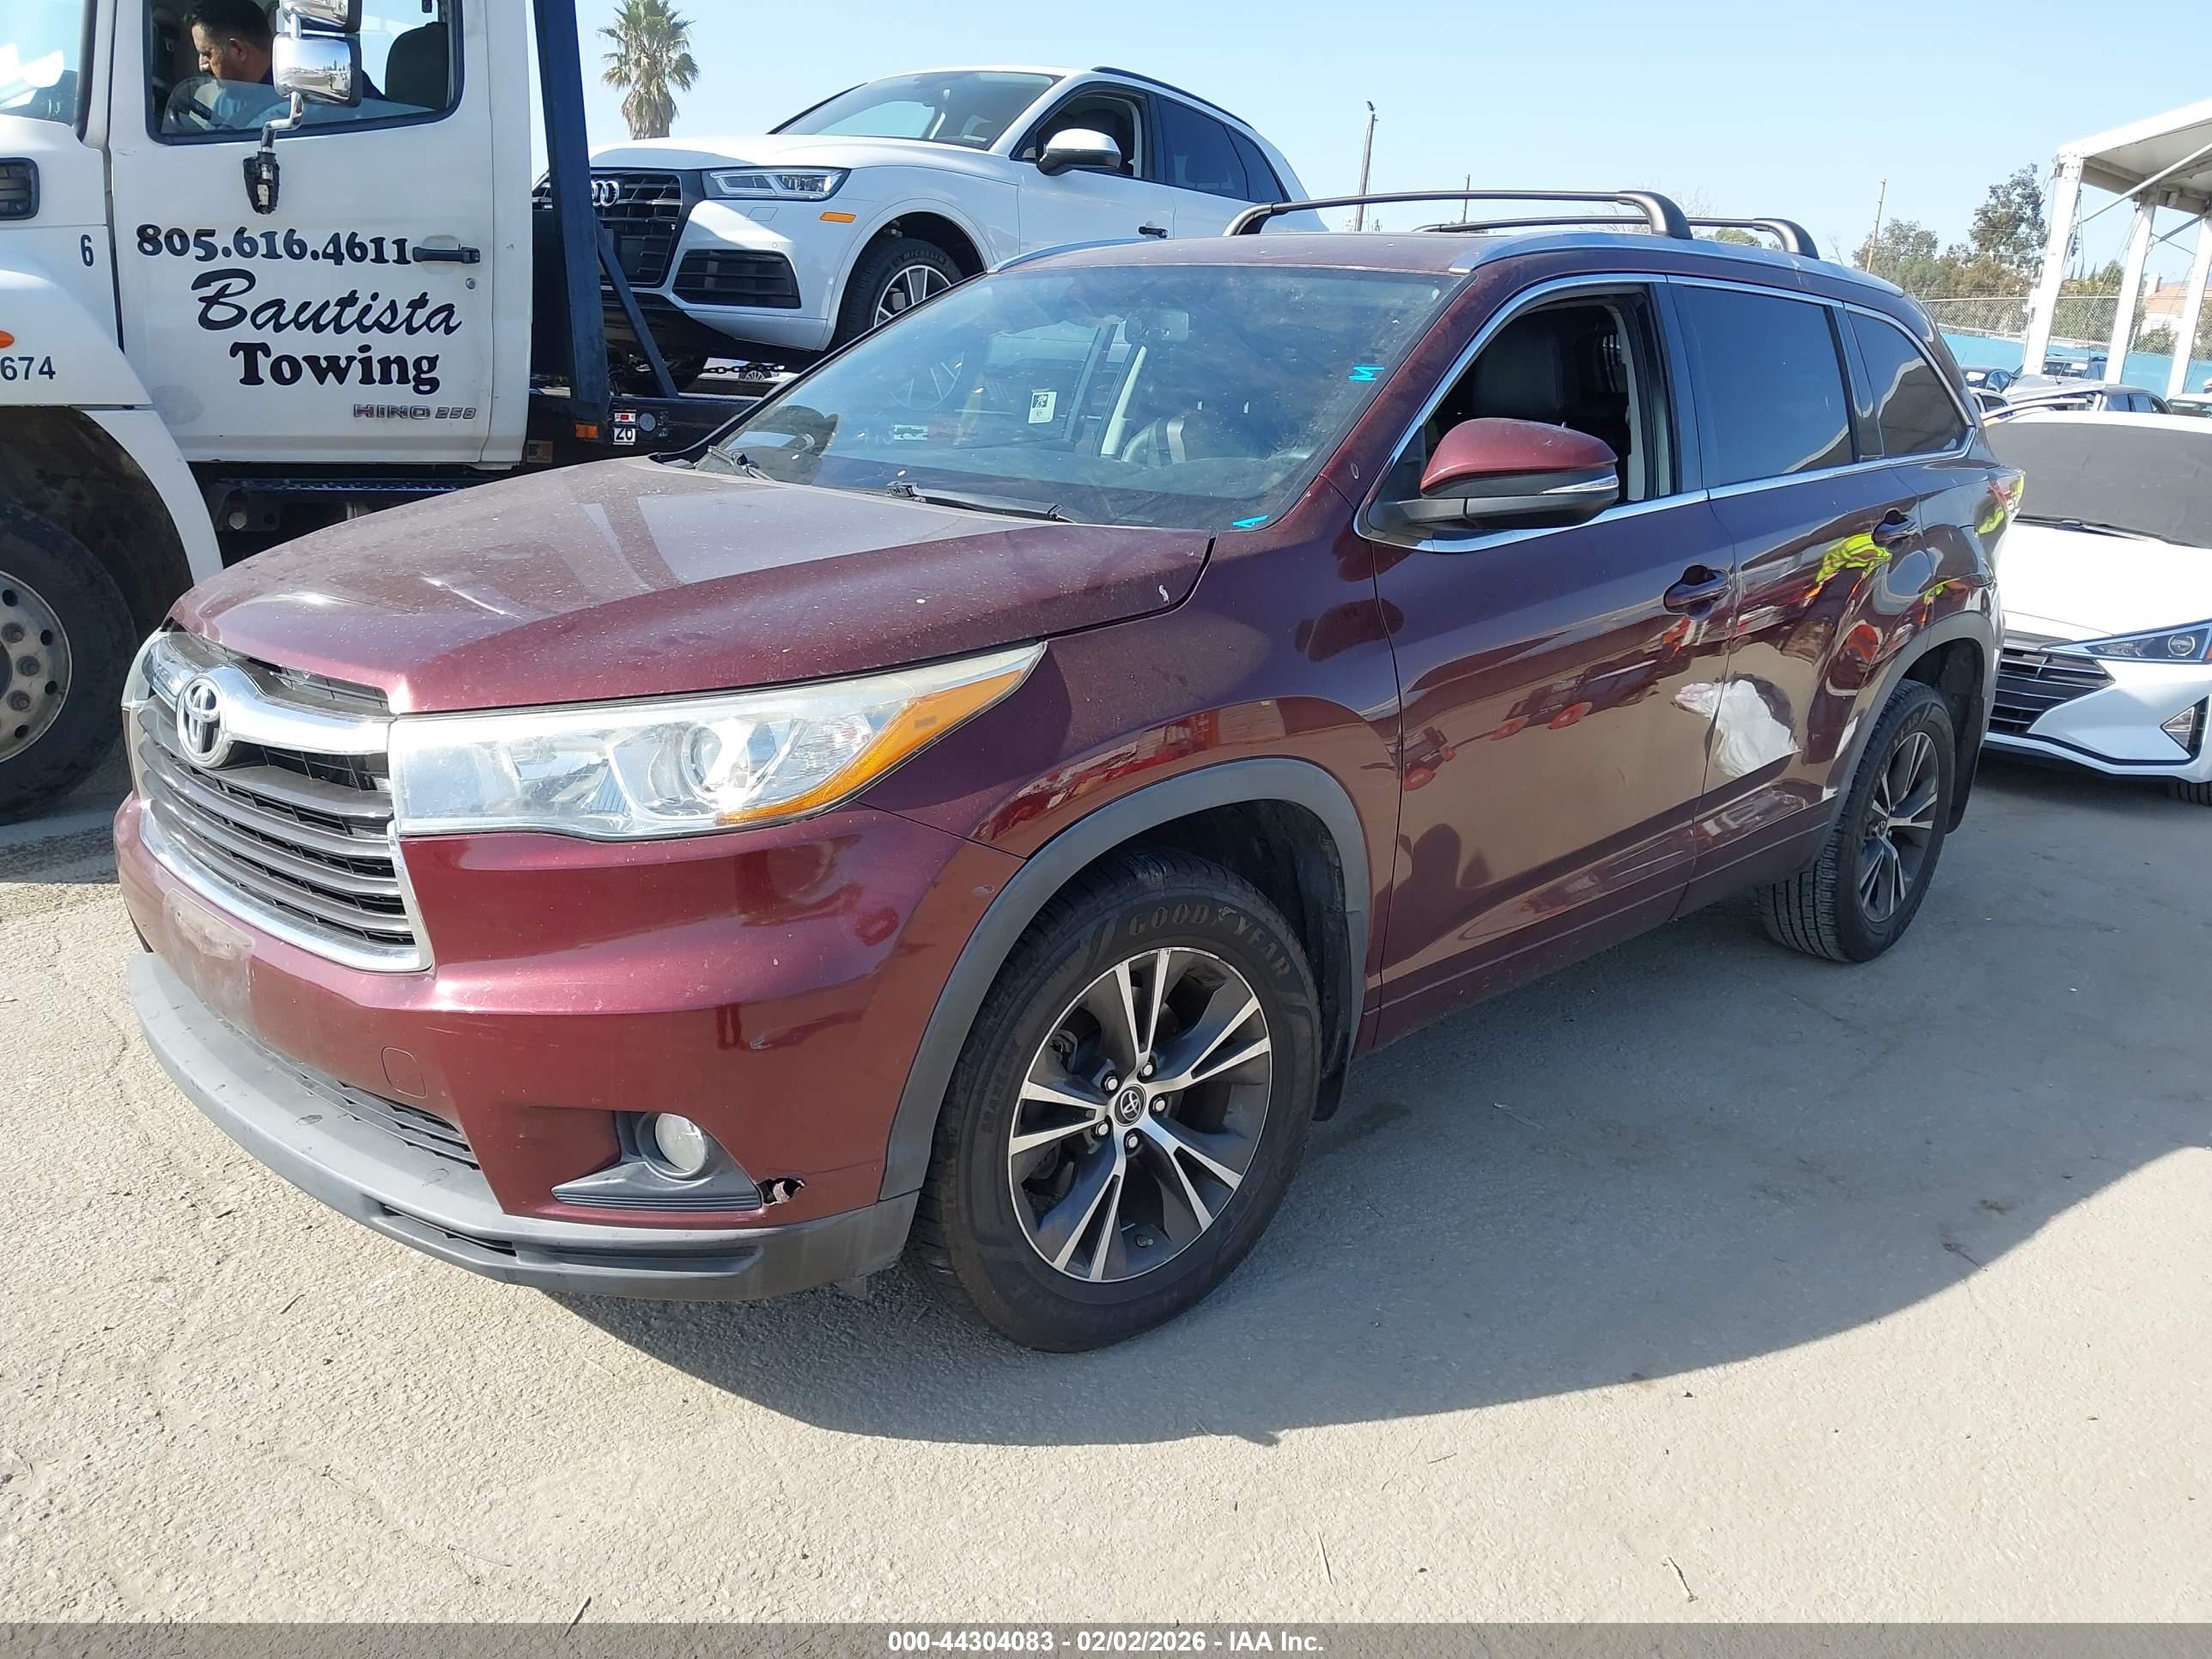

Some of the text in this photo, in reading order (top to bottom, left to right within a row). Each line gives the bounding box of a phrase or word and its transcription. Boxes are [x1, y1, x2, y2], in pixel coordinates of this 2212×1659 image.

[80, 234, 94, 267] 6
[136, 223, 411, 266] 805.616.4611
[191, 268, 462, 336] Bautista
[0, 356, 56, 380] 674
[229, 342, 441, 395] Towing
[353, 404, 477, 420] HINO 258
